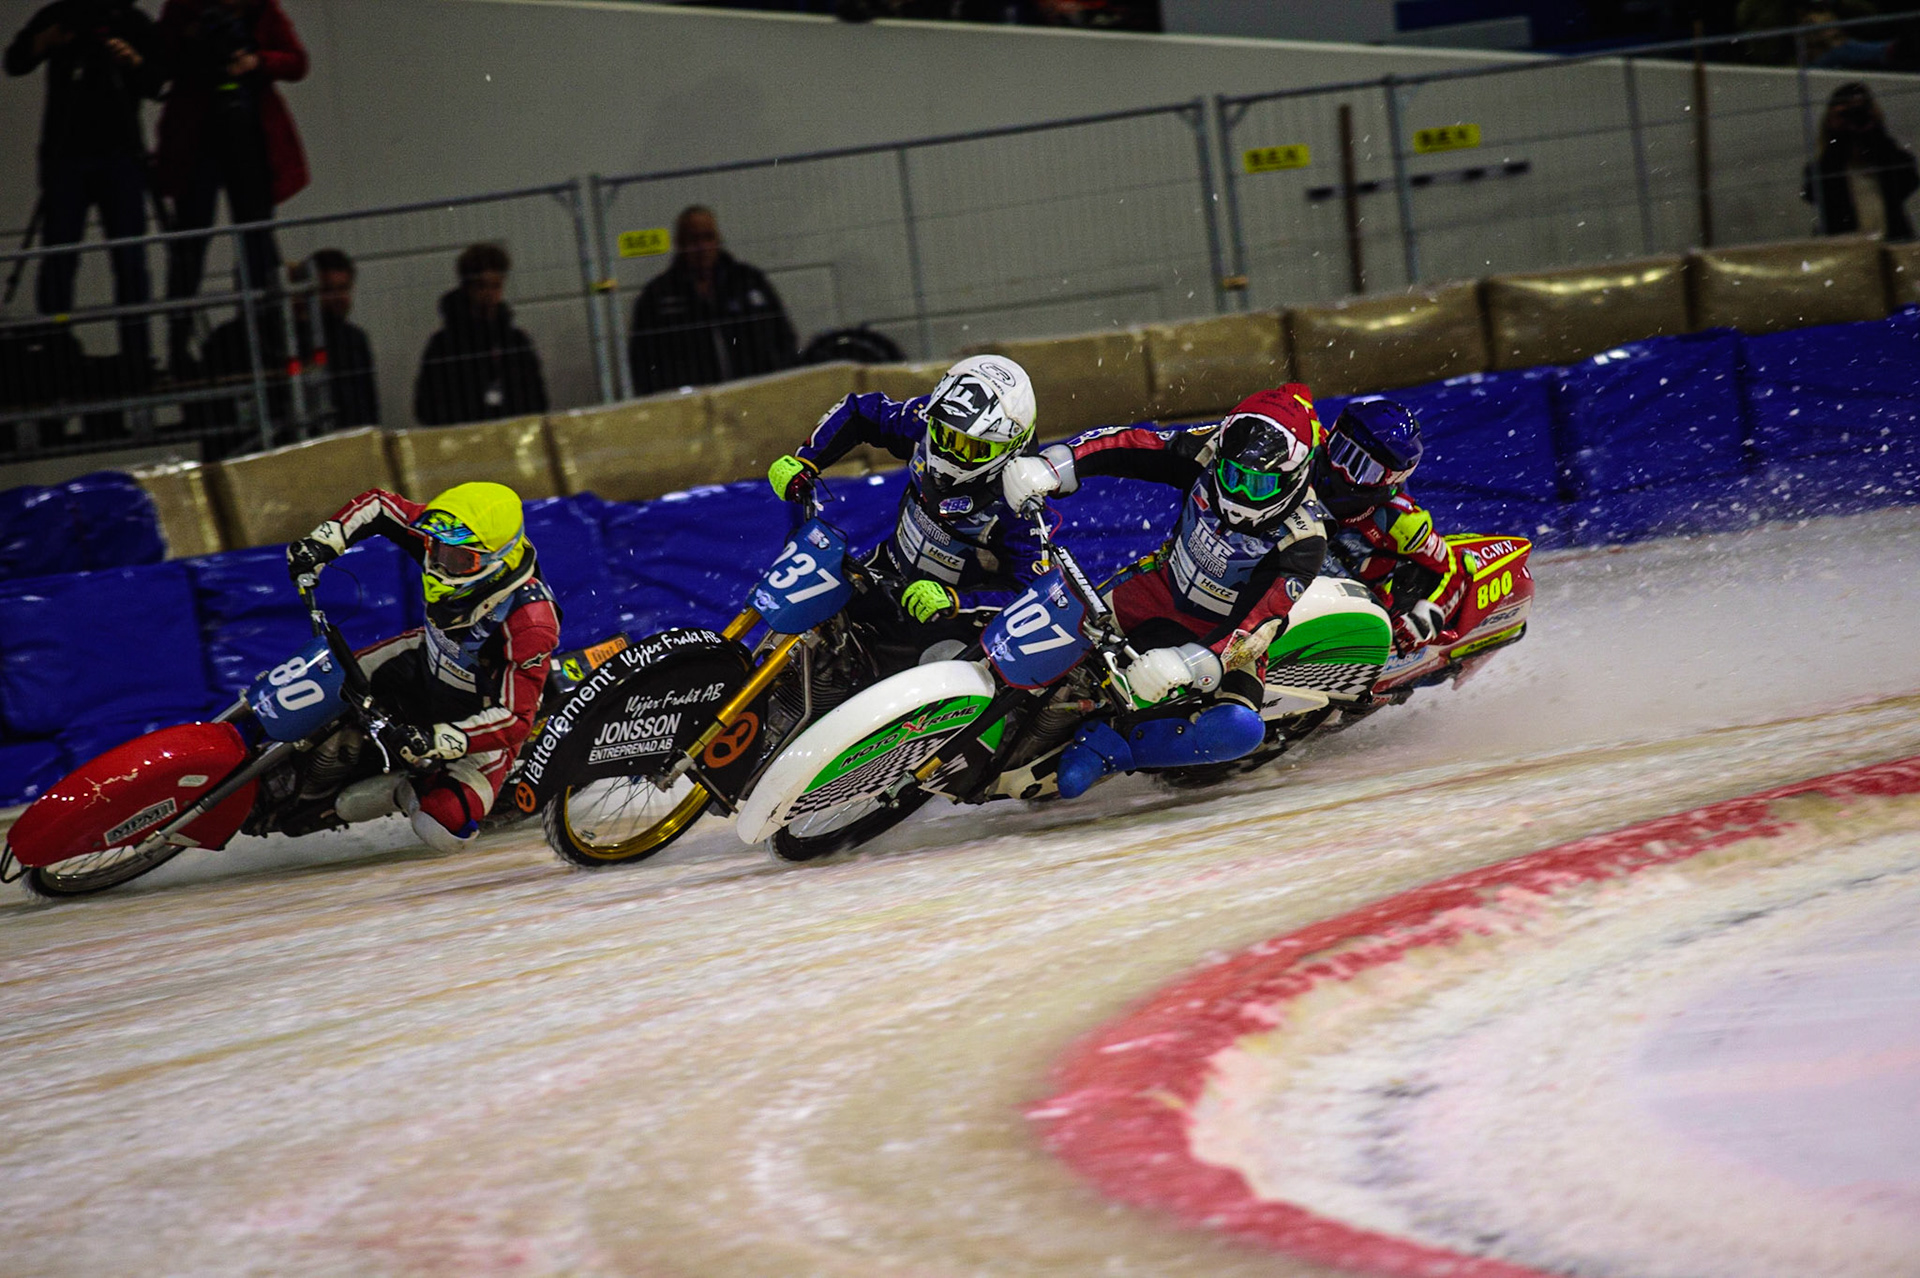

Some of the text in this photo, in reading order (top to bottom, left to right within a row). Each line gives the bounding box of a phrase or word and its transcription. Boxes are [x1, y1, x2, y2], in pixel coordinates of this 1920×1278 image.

[1190, 516, 1236, 564] ICE
[1480, 540, 1518, 559] C.W.V.
[928, 547, 960, 565] Hertz
[1201, 578, 1233, 598] Hertz
[1477, 570, 1513, 610] 800
[1003, 588, 1077, 656] 107
[701, 630, 722, 644] AB
[268, 656, 325, 711] 80
[700, 682, 725, 703] AB
[594, 712, 682, 746] JONSSON
[588, 738, 674, 762] ENTREPRENAD AB
[838, 733, 900, 770] MOTO
